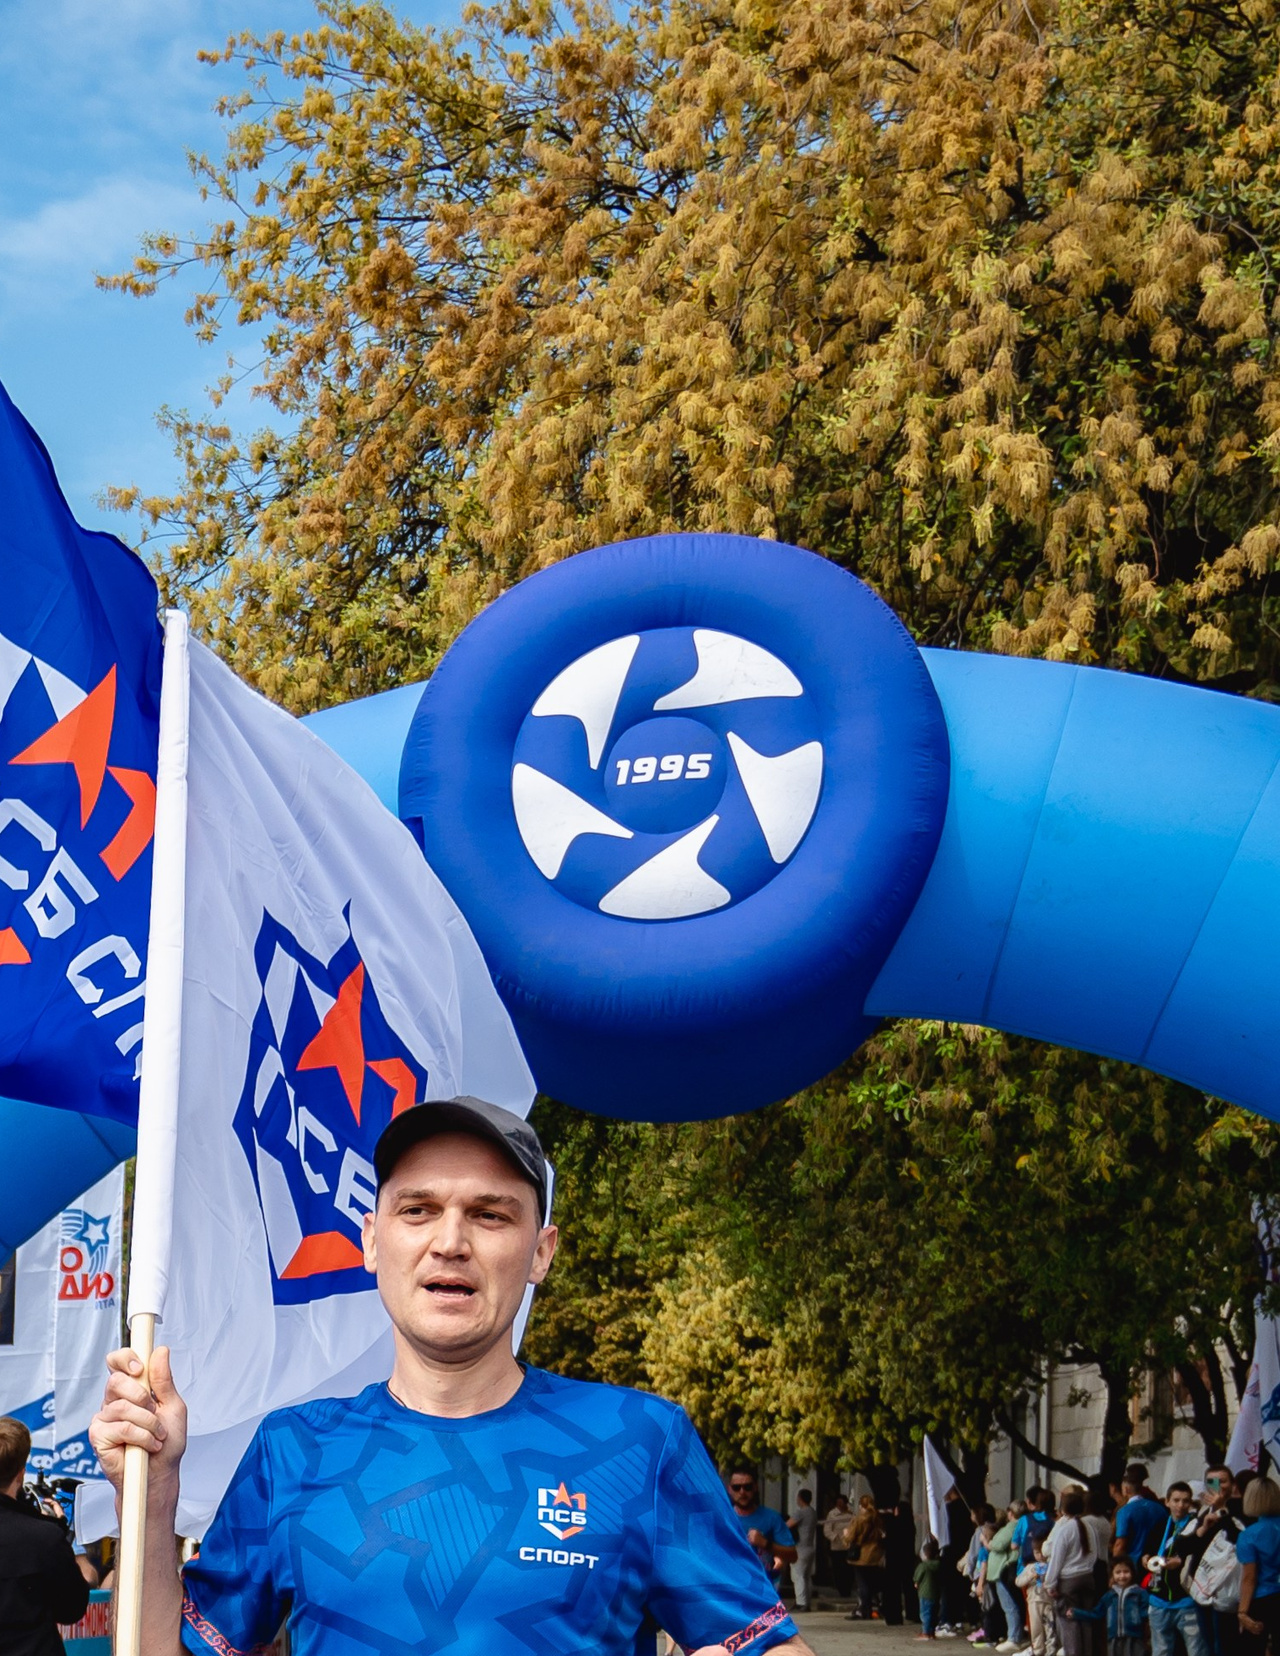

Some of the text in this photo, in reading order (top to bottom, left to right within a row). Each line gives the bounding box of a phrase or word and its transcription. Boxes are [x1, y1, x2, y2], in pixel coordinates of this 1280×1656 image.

[616, 752, 713, 786] 1995
[537, 1507, 587, 1525] ПСБ
[519, 1546, 600, 1569] СПОРТ
